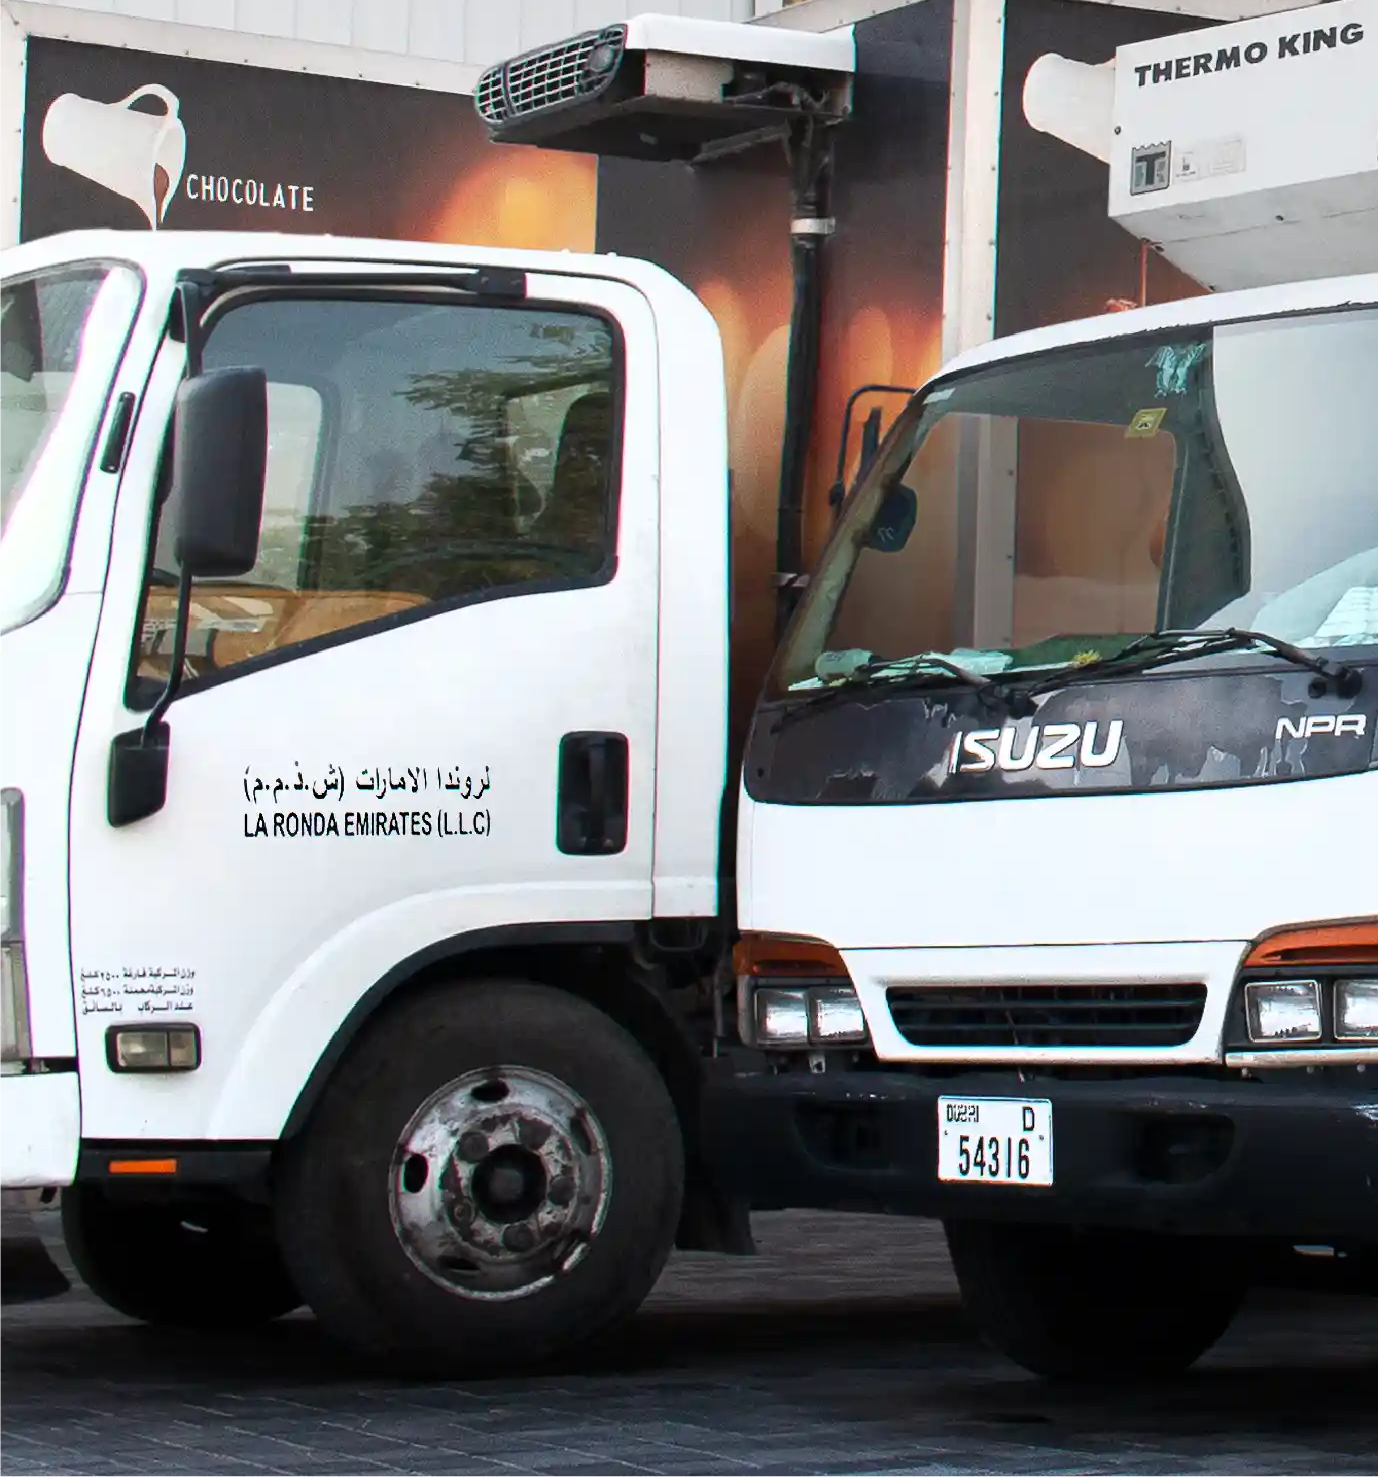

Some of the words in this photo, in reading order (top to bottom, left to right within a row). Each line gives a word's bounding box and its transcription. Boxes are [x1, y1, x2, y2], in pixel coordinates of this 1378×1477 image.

[1134, 41, 1269, 88] THERMO
[1277, 22, 1365, 60] KING
[186, 173, 315, 213] CHOCOLATE
[948, 719, 1125, 773] ISUZU
[1275, 713, 1368, 740] NPR
[244, 812, 269, 838] LA
[273, 811, 340, 837] RONDA
[344, 810, 433, 837] EMIRATES
[1021, 1106, 1036, 1132] D
[958, 1134, 1031, 1180] 54316
